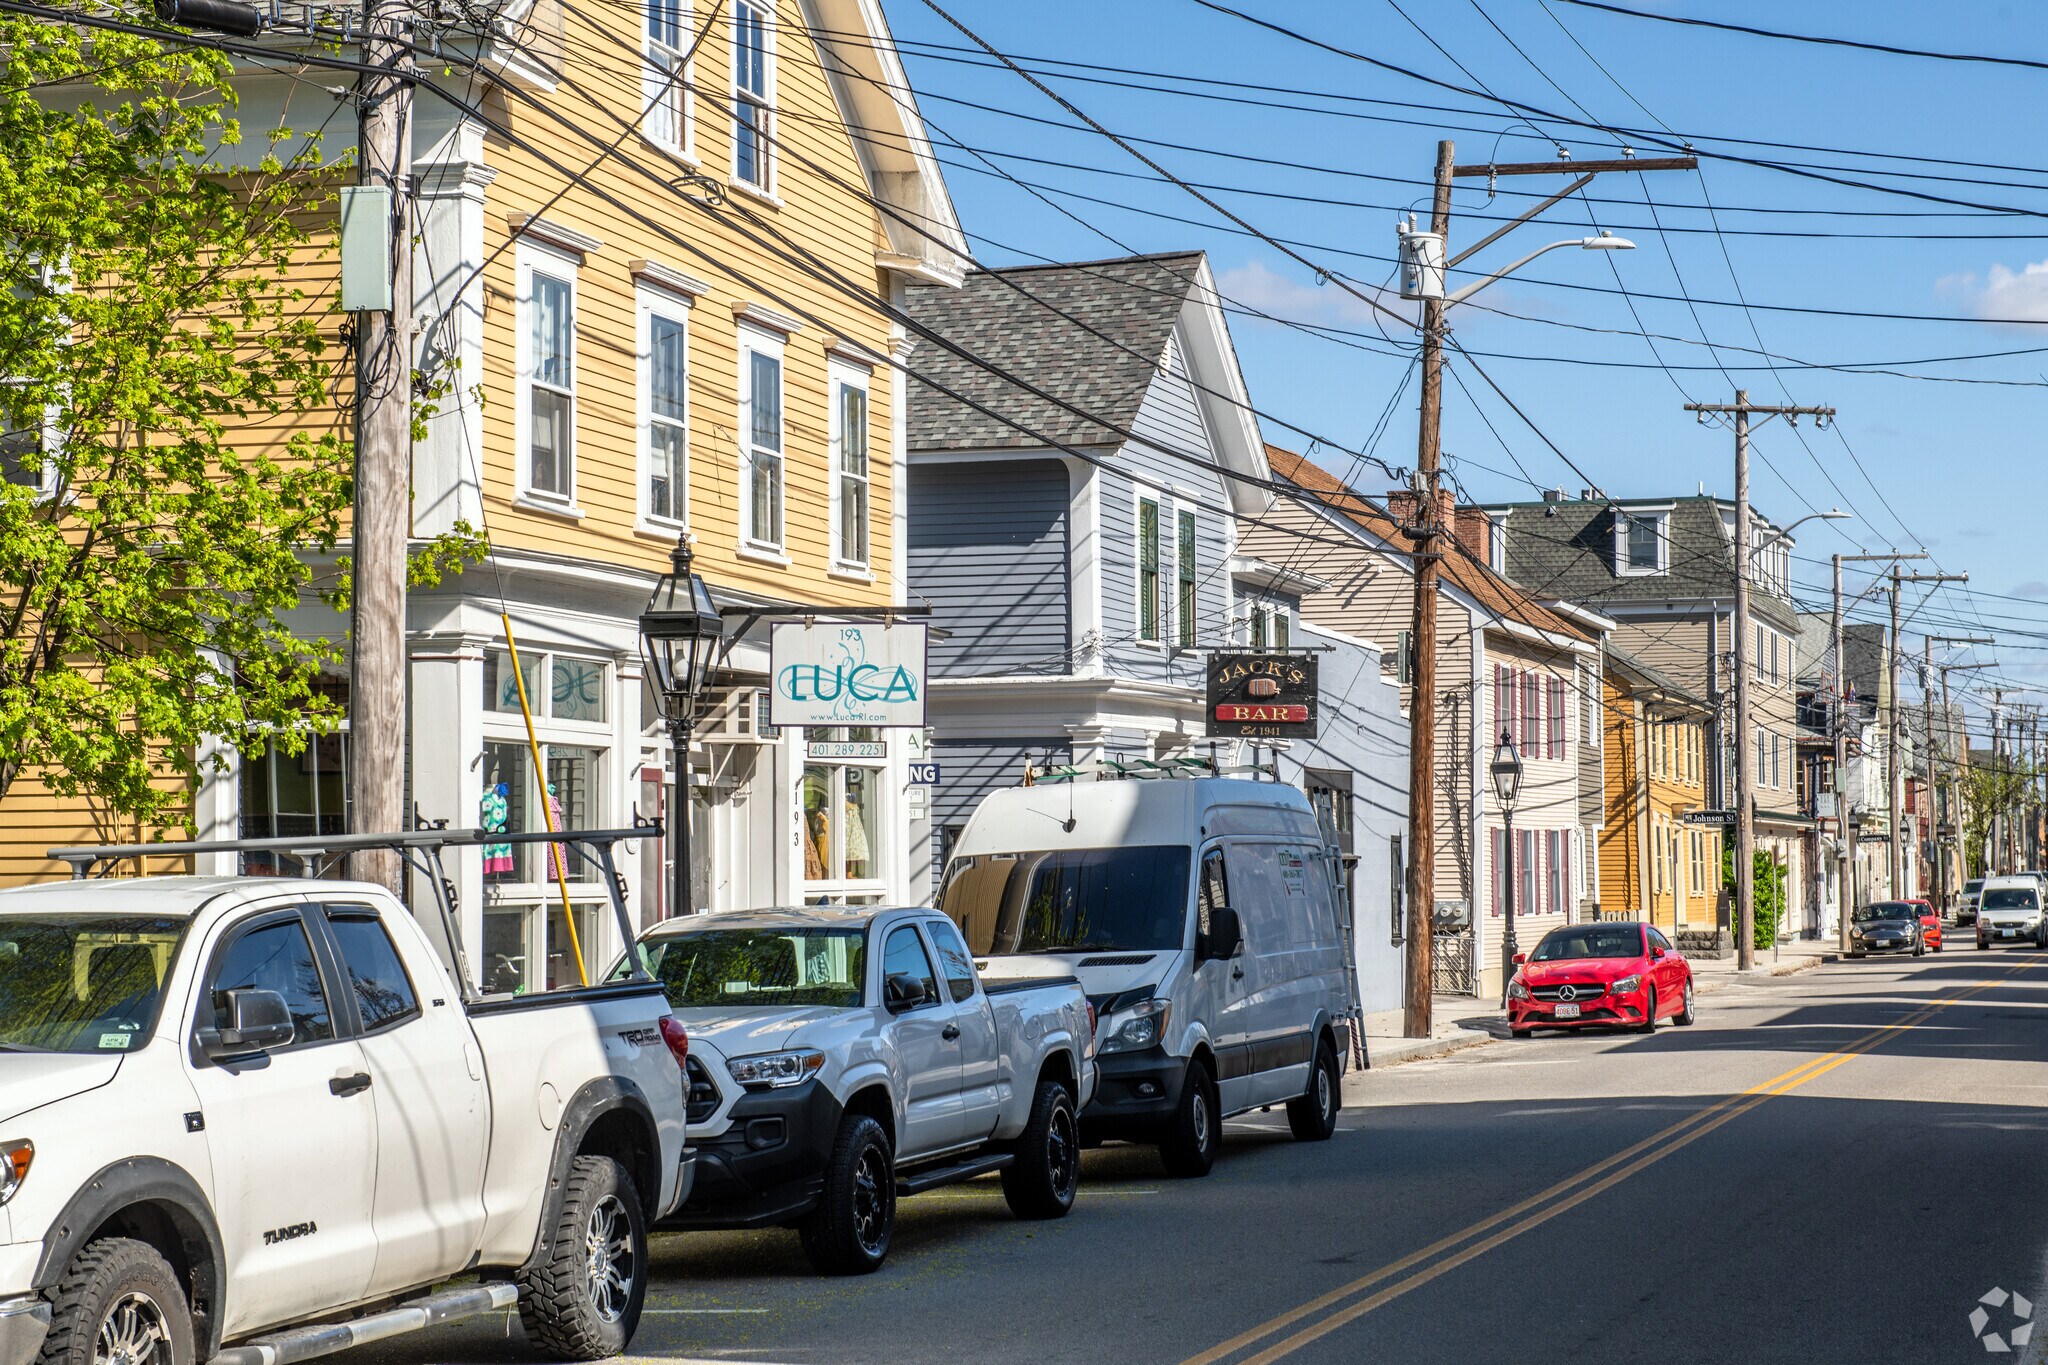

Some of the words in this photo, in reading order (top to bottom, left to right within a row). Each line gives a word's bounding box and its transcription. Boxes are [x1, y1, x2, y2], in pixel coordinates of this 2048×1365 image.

[839, 629, 861, 642] 193
[1219, 661, 1306, 684] JACK'S
[791, 664, 918, 701] LUCA
[1233, 706, 1289, 720] BAR
[1259, 726, 1280, 736] 1941
[812, 744, 884, 756] 401.289.2251
[1693, 813, 1724, 823] Johnson
[1726, 813, 1735, 822] St
[618, 1029, 644, 1048] TRD
[263, 1220, 318, 1245] TUNDRA
